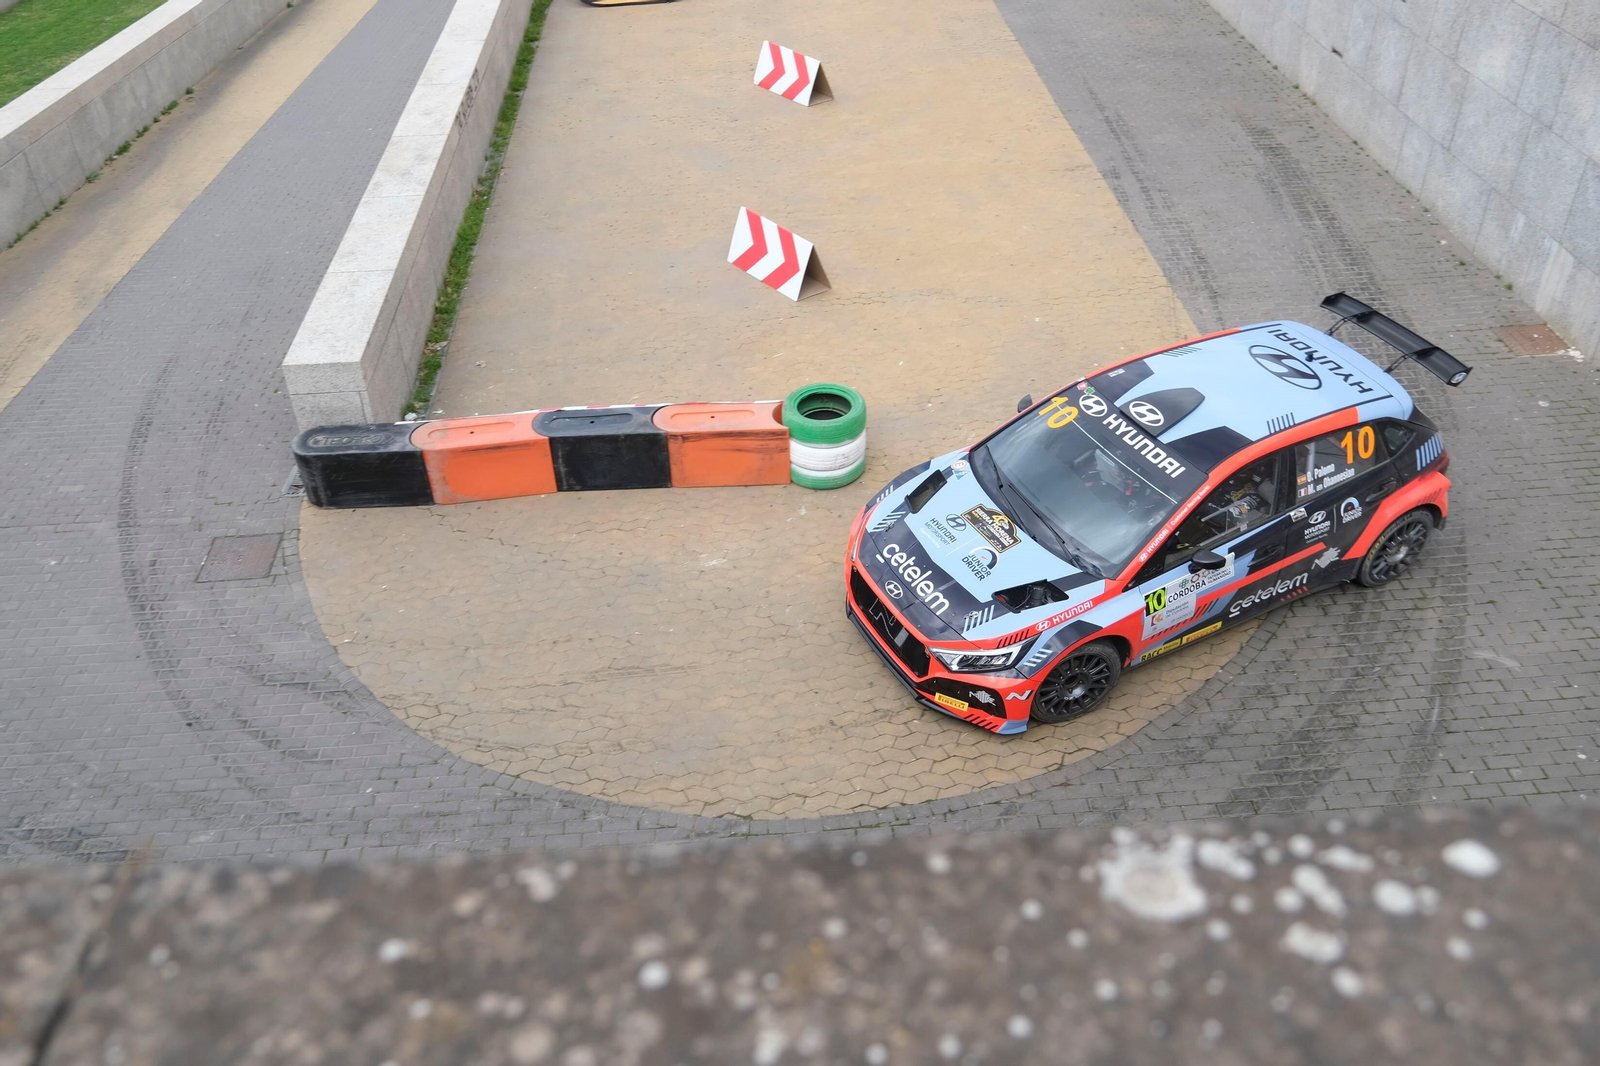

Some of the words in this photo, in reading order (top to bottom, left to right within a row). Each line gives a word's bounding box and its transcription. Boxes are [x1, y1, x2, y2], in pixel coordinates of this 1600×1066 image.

[1267, 328, 1374, 394] HYUNDAI
[1038, 396, 1079, 429] 10
[1101, 413, 1187, 479] HYUNDAI
[1340, 425, 1376, 465] 10
[924, 521, 951, 546] MOTORSPORT
[929, 517, 958, 543] HYUNDAI
[974, 507, 994, 526] SIERRA
[990, 522, 1015, 546] MORENA
[1304, 520, 1331, 536] HYUNDAI
[1146, 528, 1170, 553] HYUNDAI
[961, 557, 986, 582] DRIVER
[967, 553, 992, 578] JUNIOR
[881, 543, 950, 616] cetelem
[1144, 589, 1167, 614] 10
[1229, 572, 1309, 613] cetelem
[1052, 600, 1094, 624] HYUNDAI
[1140, 647, 1163, 662] RACC
